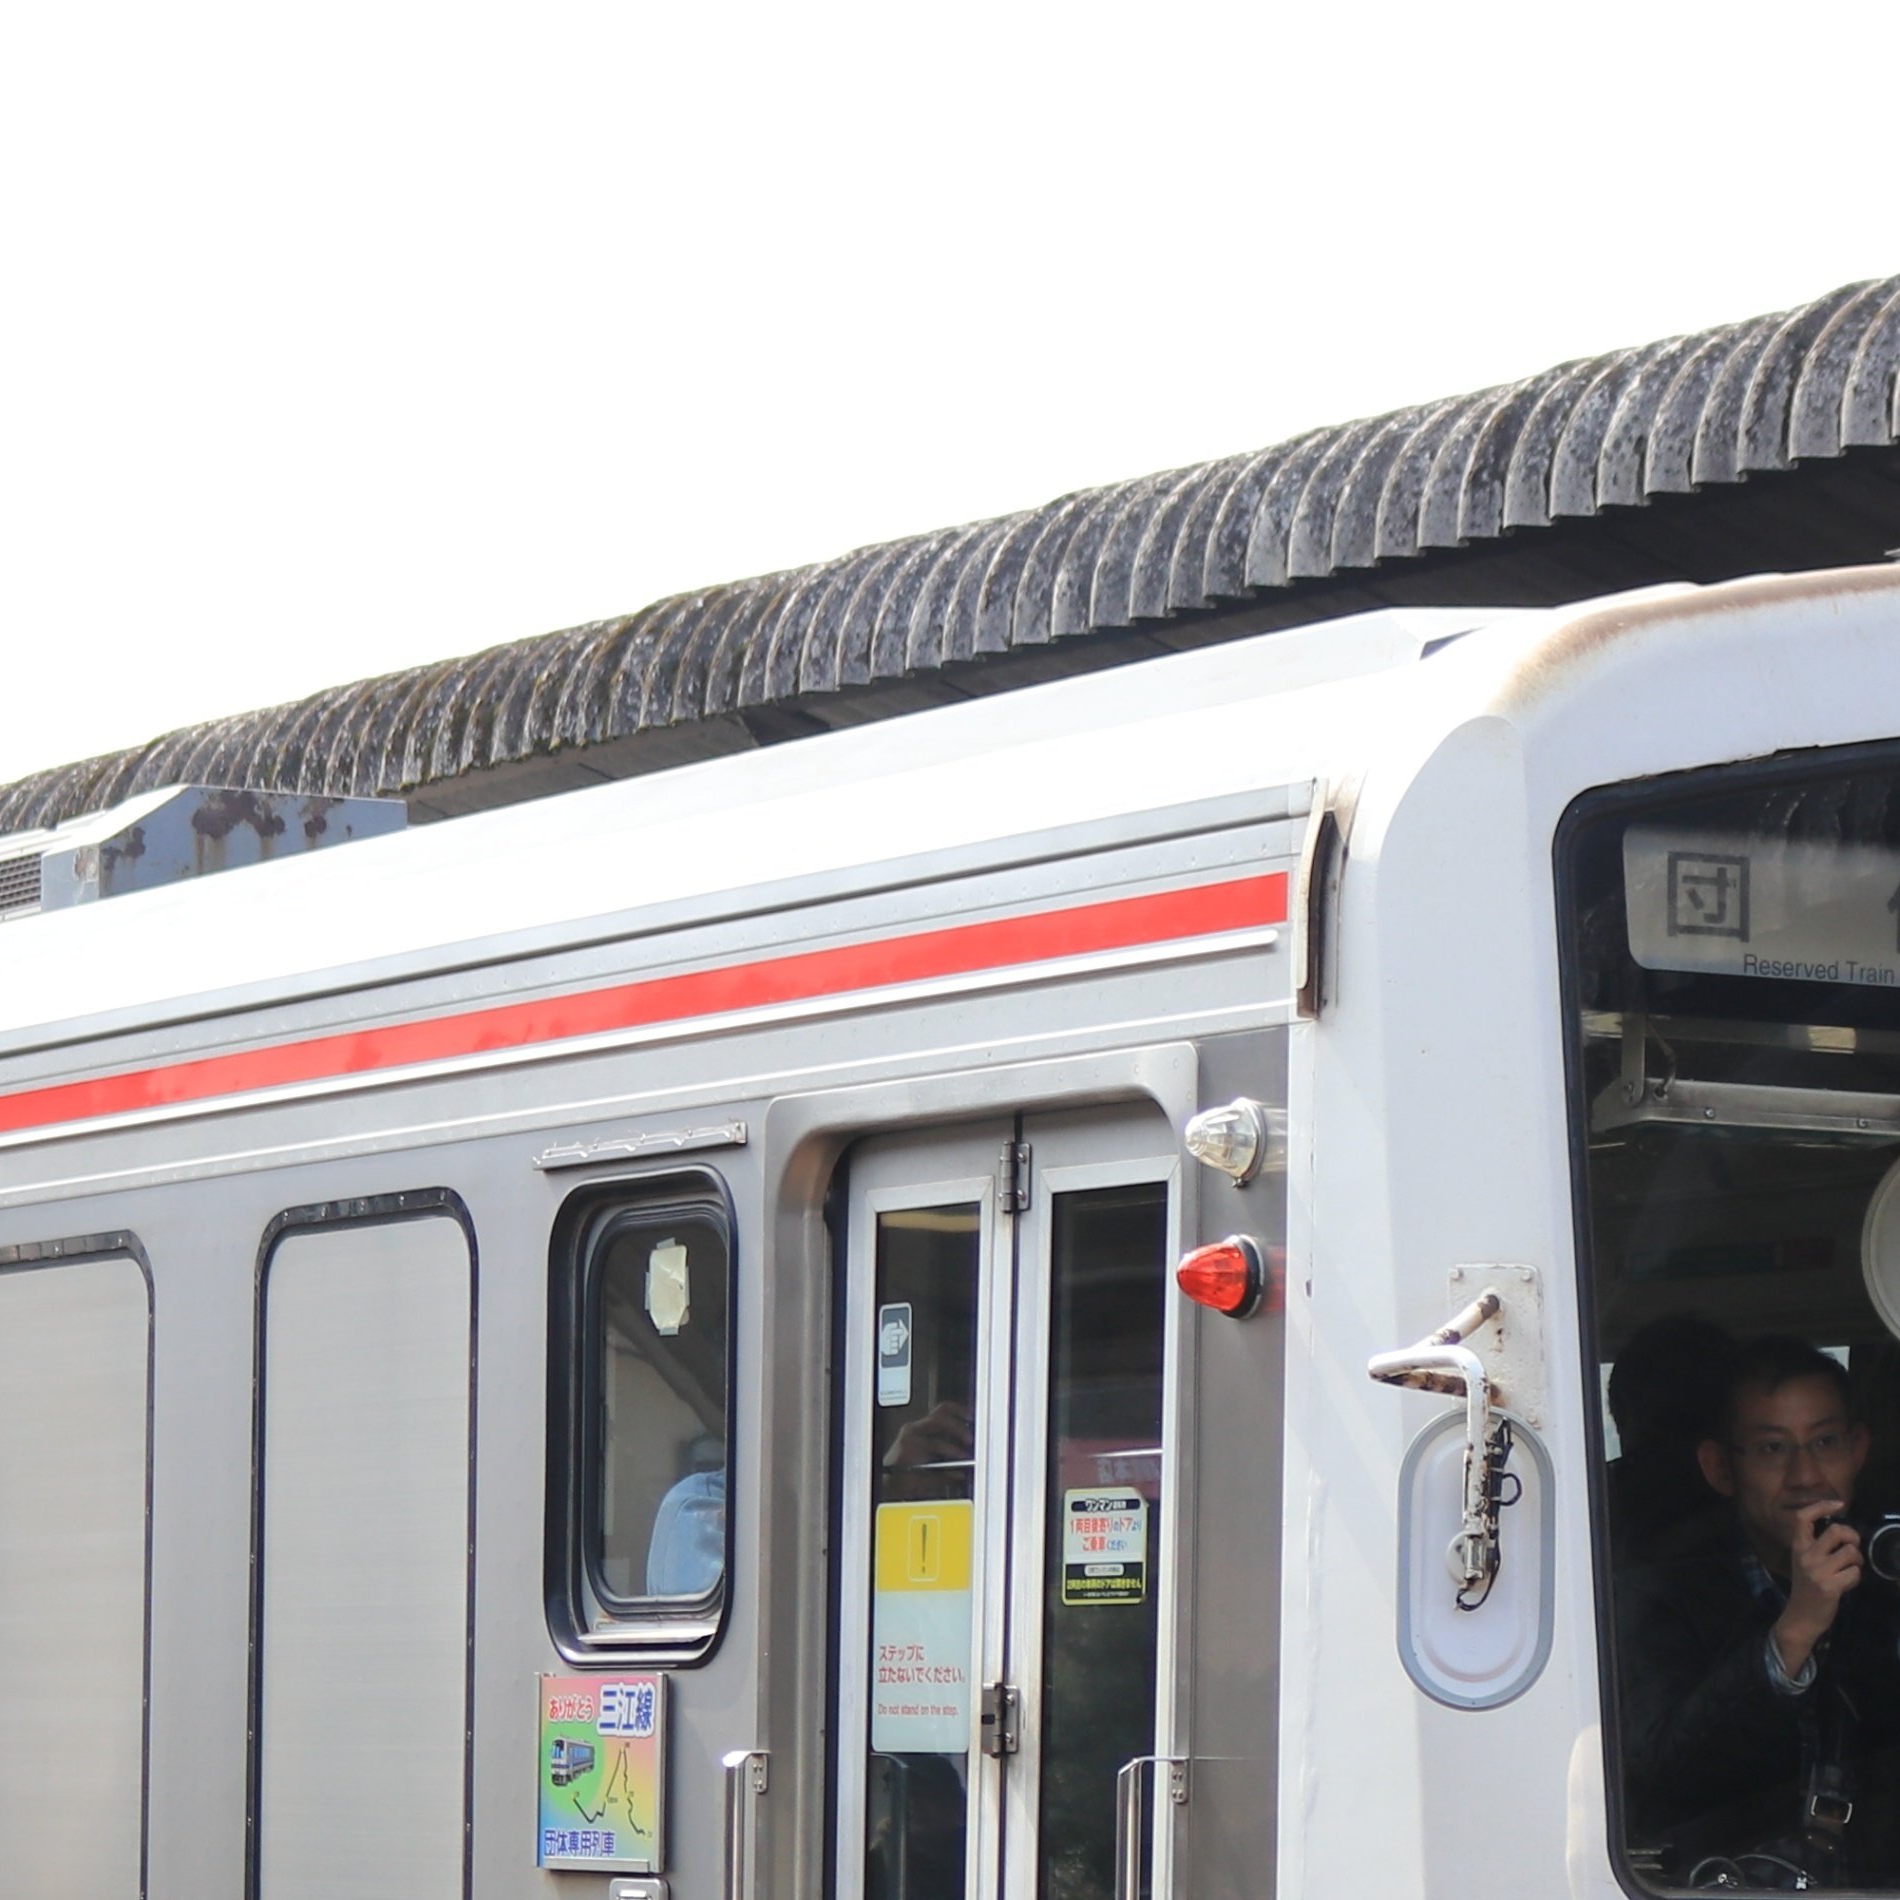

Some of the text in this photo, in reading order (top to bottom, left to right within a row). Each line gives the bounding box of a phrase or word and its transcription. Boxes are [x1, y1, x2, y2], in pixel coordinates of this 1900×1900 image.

[1743, 953, 1895, 984] Reserved Train
[879, 1644, 925, 1661] ステップに
[878, 1665, 966, 1684] 立たないでください。
[549, 1696, 593, 1720] ありがとう
[600, 1688, 653, 1731] 三江線
[878, 1704, 959, 1717] Do not stand on the step.
[544, 1829, 616, 1857] 団体専用列車
